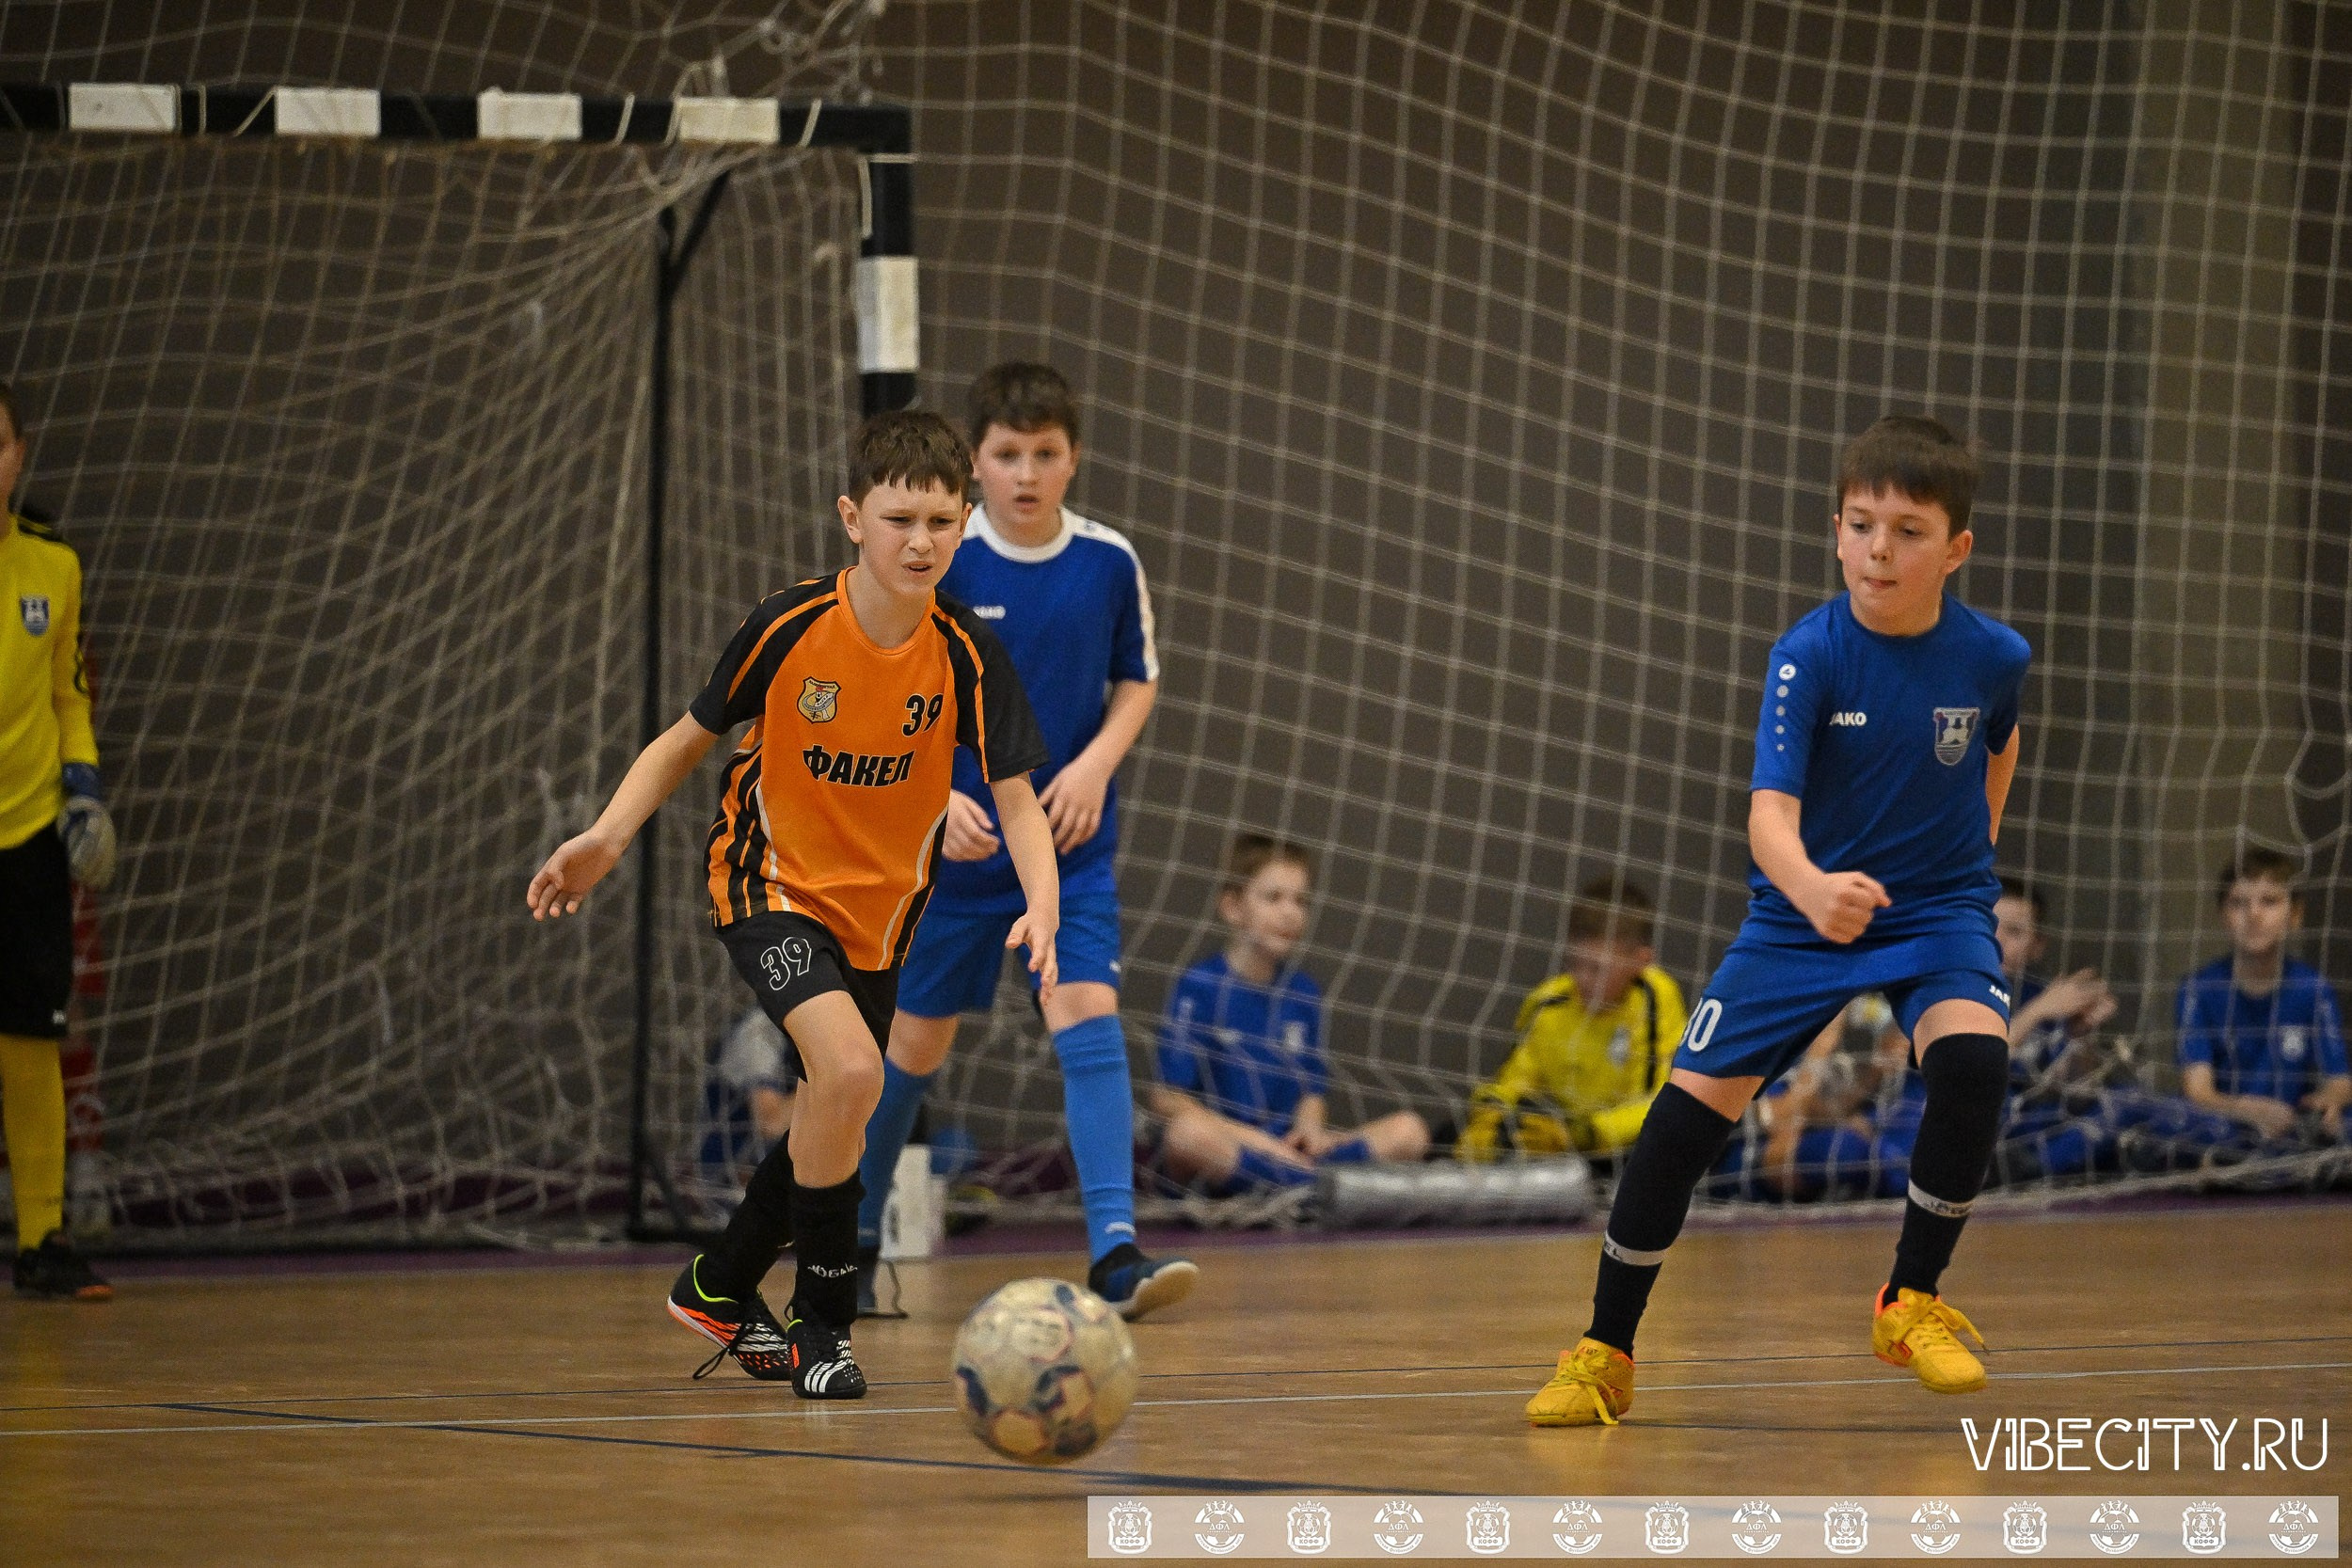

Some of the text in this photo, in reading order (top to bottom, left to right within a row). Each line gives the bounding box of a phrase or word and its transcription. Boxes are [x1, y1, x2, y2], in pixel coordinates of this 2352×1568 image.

[901, 692, 944, 737] 39
[1829, 712, 1867, 726] AKO
[802, 744, 915, 787] ФАКЕЛ
[760, 936, 812, 990] 39
